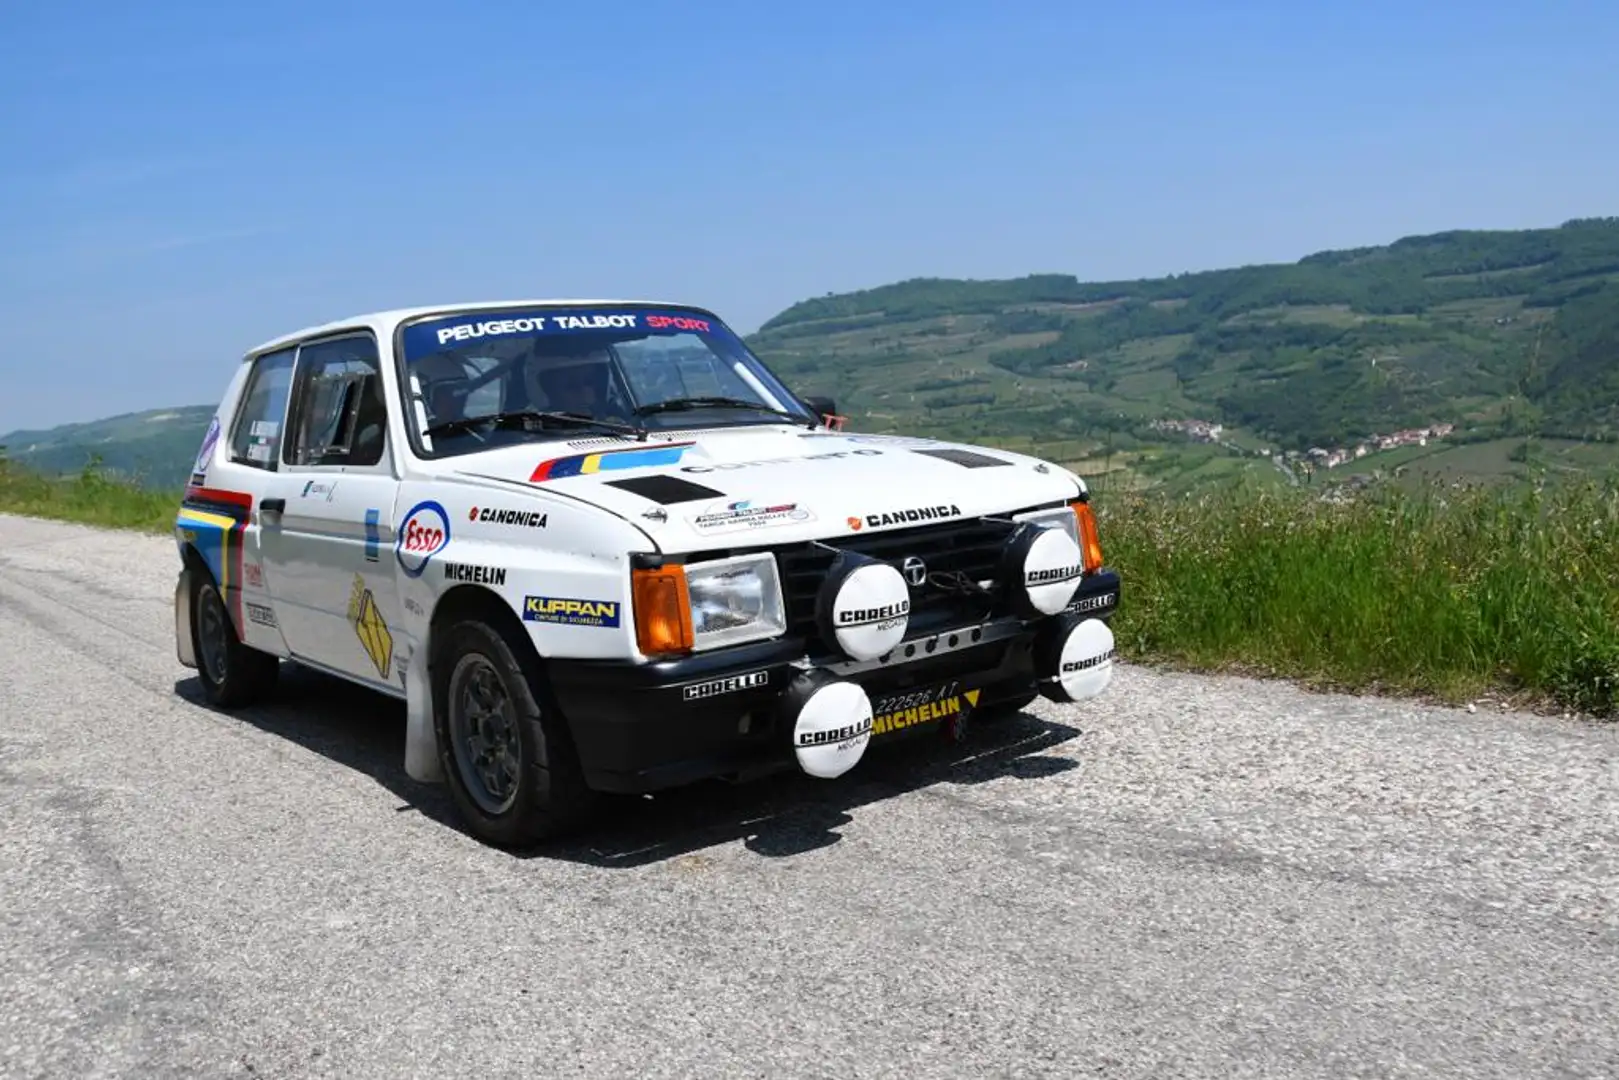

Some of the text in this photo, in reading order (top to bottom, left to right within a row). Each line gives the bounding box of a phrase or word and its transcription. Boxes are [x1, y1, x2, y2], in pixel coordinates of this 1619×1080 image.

[437, 315, 710, 344] PEUGEOT TALBOT SPORT
[480, 508, 548, 528] CANONICA
[867, 504, 961, 528] CANONICA
[444, 562, 507, 585] MICHELIN
[527, 598, 615, 618] KLIPPAN
[840, 600, 908, 622] CARELLO
[684, 672, 767, 699] CARELLO
[871, 696, 960, 735] MICHELIN
[800, 717, 870, 744] CARELLO
